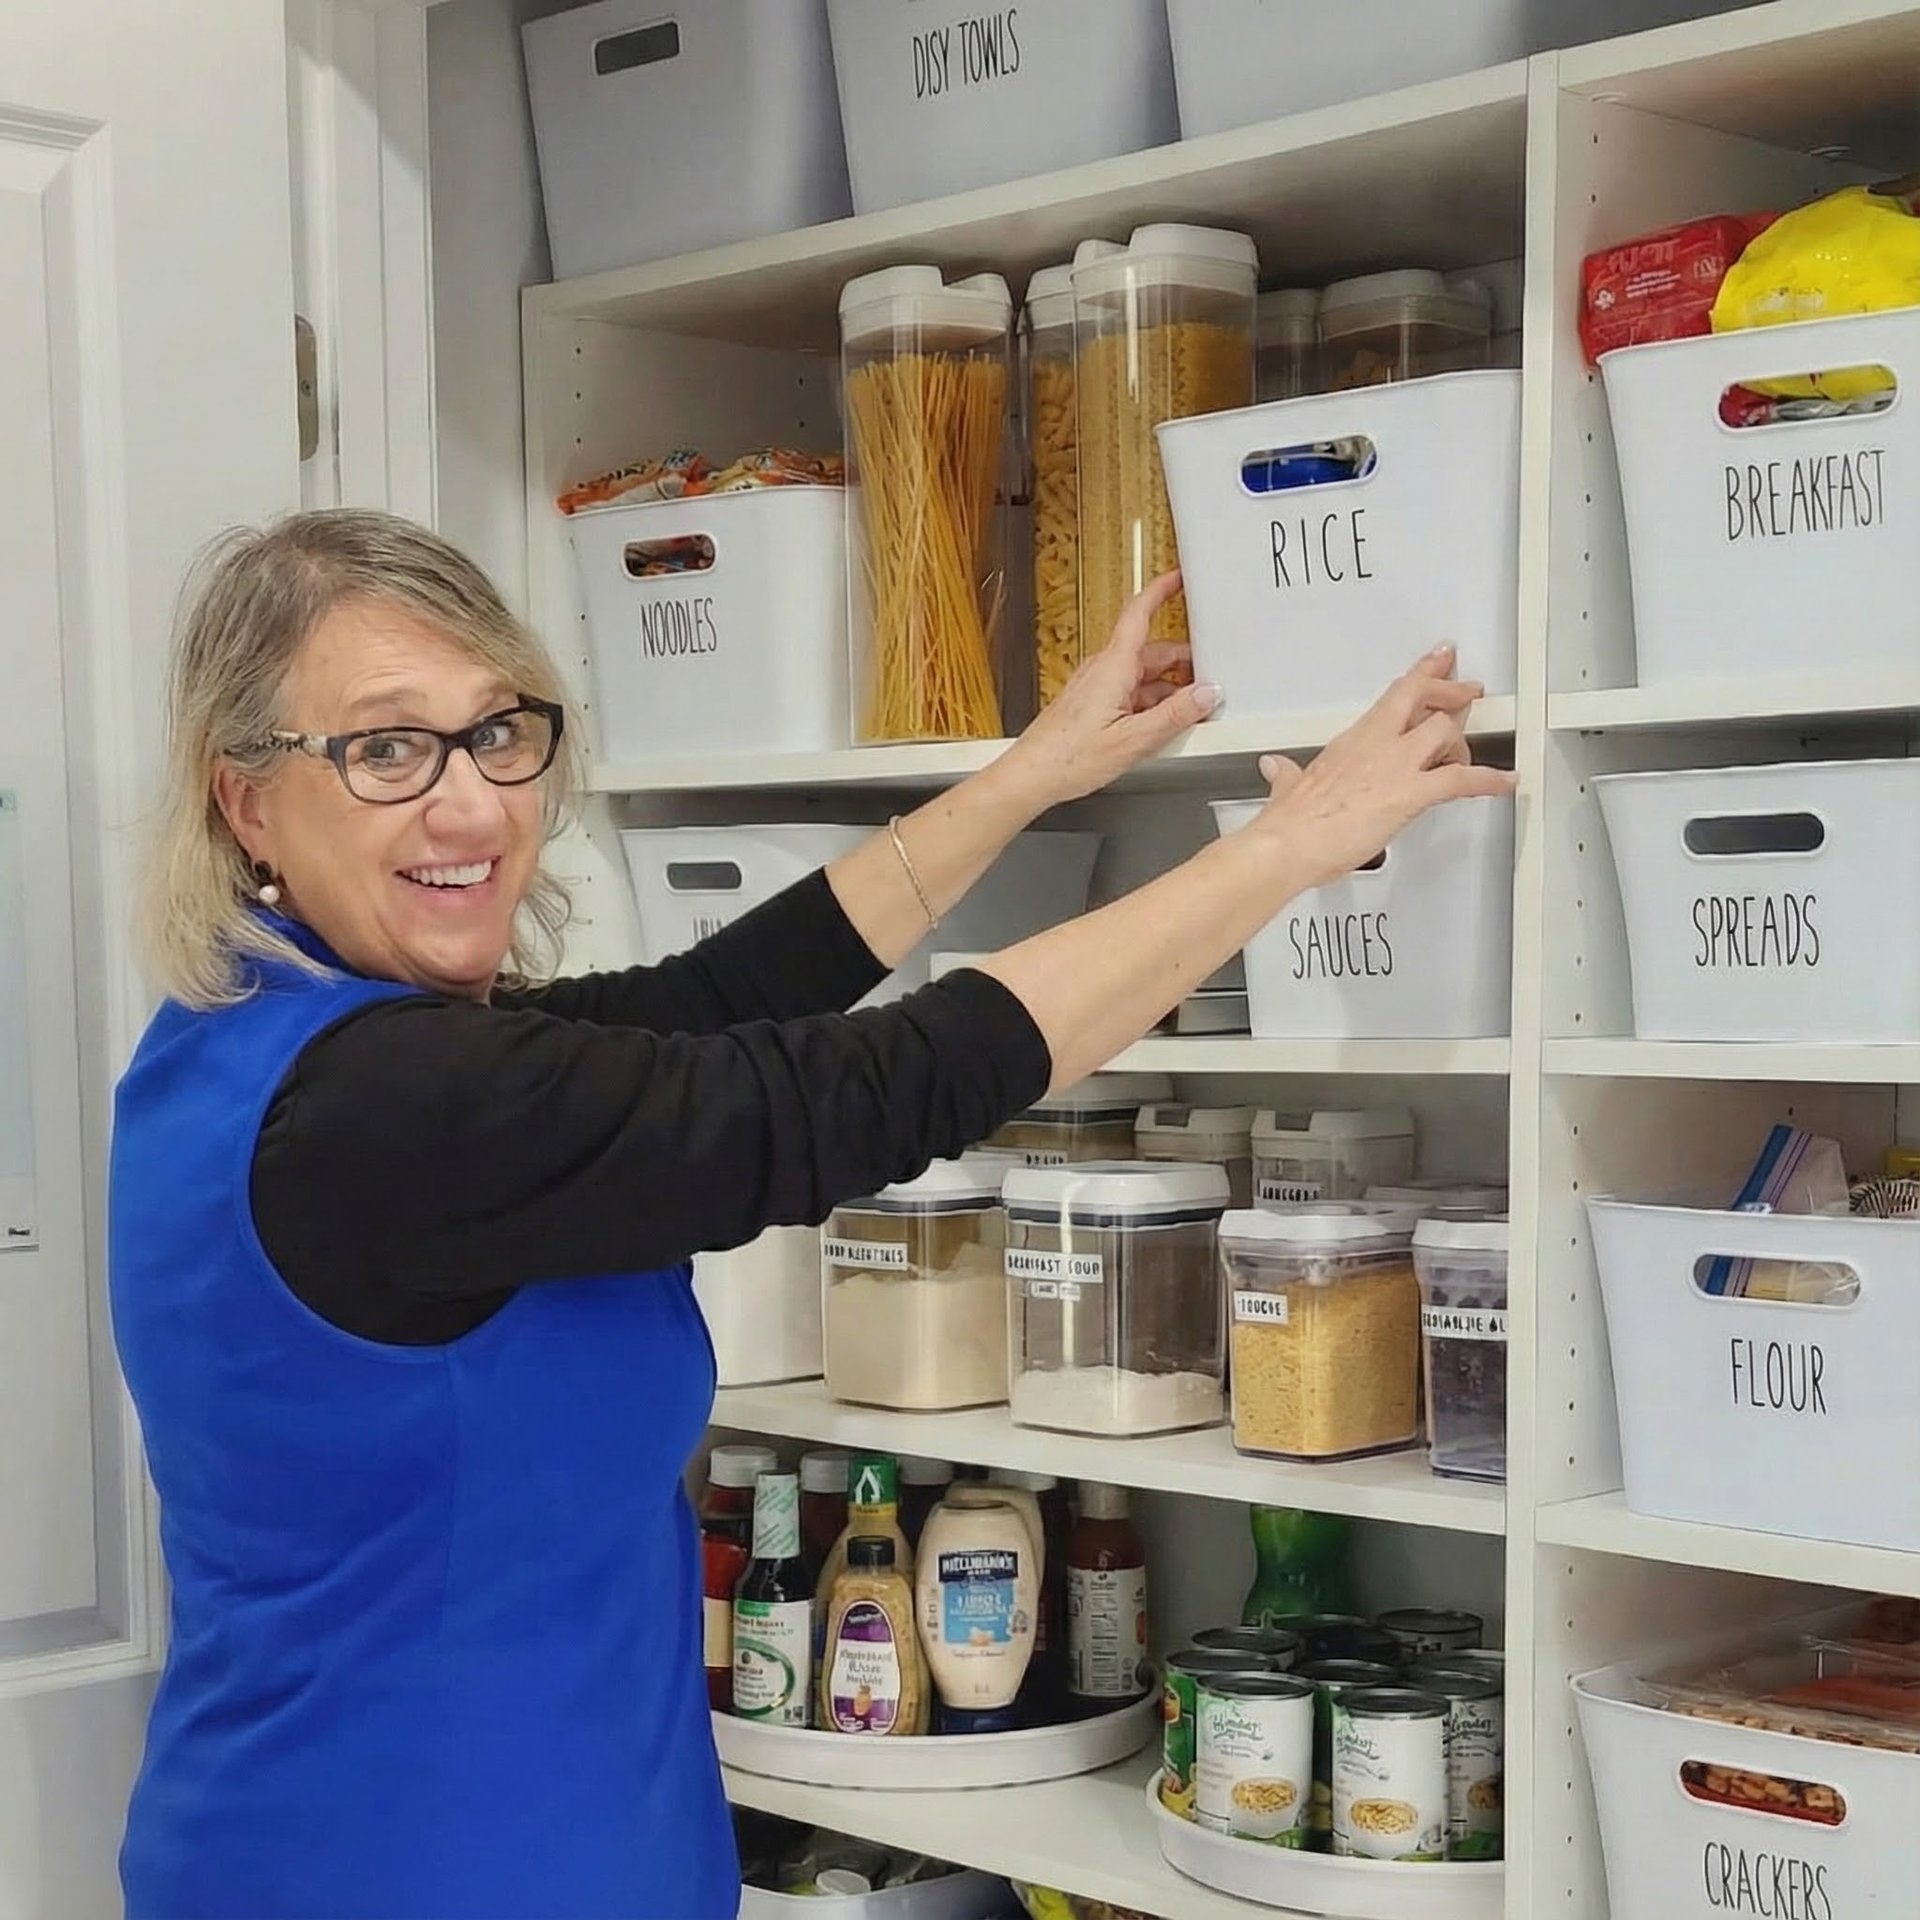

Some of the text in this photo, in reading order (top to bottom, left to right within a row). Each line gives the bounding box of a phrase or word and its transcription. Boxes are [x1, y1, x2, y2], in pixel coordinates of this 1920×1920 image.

[913, 9, 1020, 98] DISY TOWLS
[1726, 450, 1885, 541] BREAKFAST
[1271, 509, 1373, 588] RICE
[641, 598, 716, 658] NOODLES
[1290, 913, 1393, 979] SAUCES
[1693, 893, 1820, 967] SPREADS
[1731, 1338, 1826, 1414] FLOUR
[1705, 1842, 1832, 1920] CRACKERS
